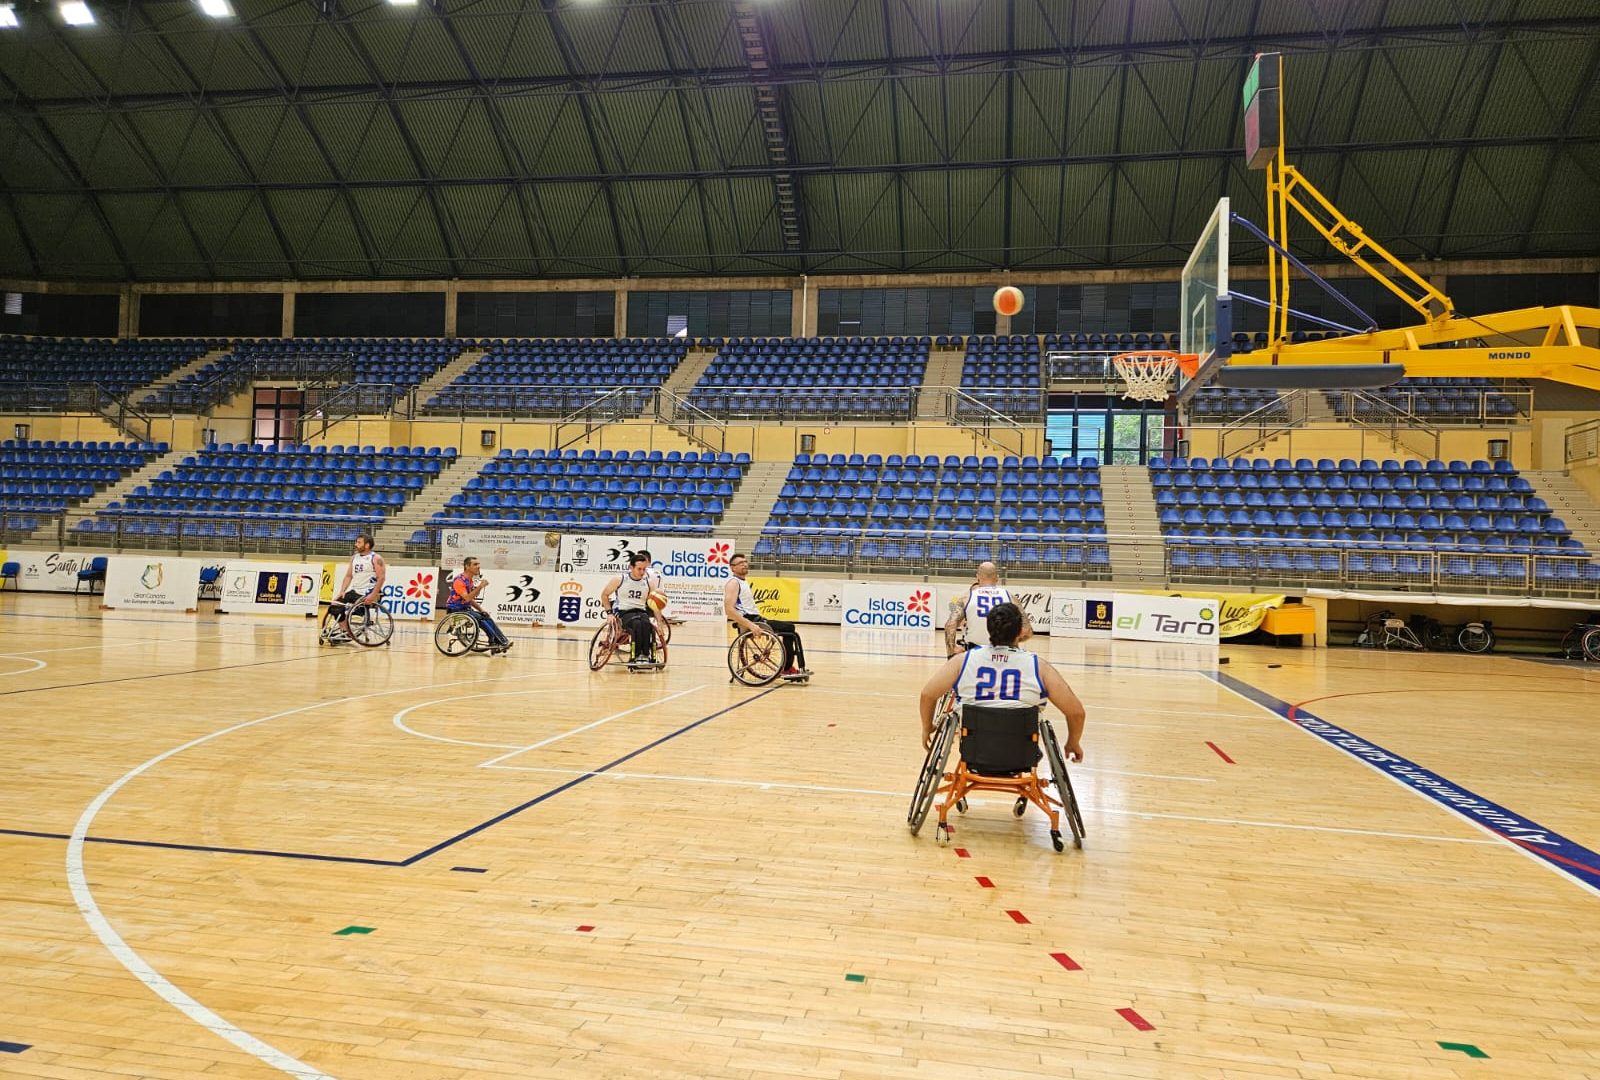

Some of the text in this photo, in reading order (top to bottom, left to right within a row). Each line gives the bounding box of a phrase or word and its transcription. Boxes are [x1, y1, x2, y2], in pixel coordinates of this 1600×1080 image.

[1488, 352, 1531, 360] MONDO
[671, 550, 705, 563] Islas
[45, 553, 78, 576] Santa
[599, 563, 620, 571] SANTA
[628, 590, 642, 599] 32
[497, 603, 522, 613] SANTA
[869, 598, 905, 611] Islas
[585, 609, 598, 619] de
[845, 608, 931, 627] Canarias
[1116, 613, 1142, 631] el
[1151, 613, 1215, 636] Taro
[991, 654, 1009, 662] PITU
[975, 666, 1021, 701] 20
[1334, 739, 1401, 763] SANTA
[1388, 764, 1561, 846] Ayuntamiento
